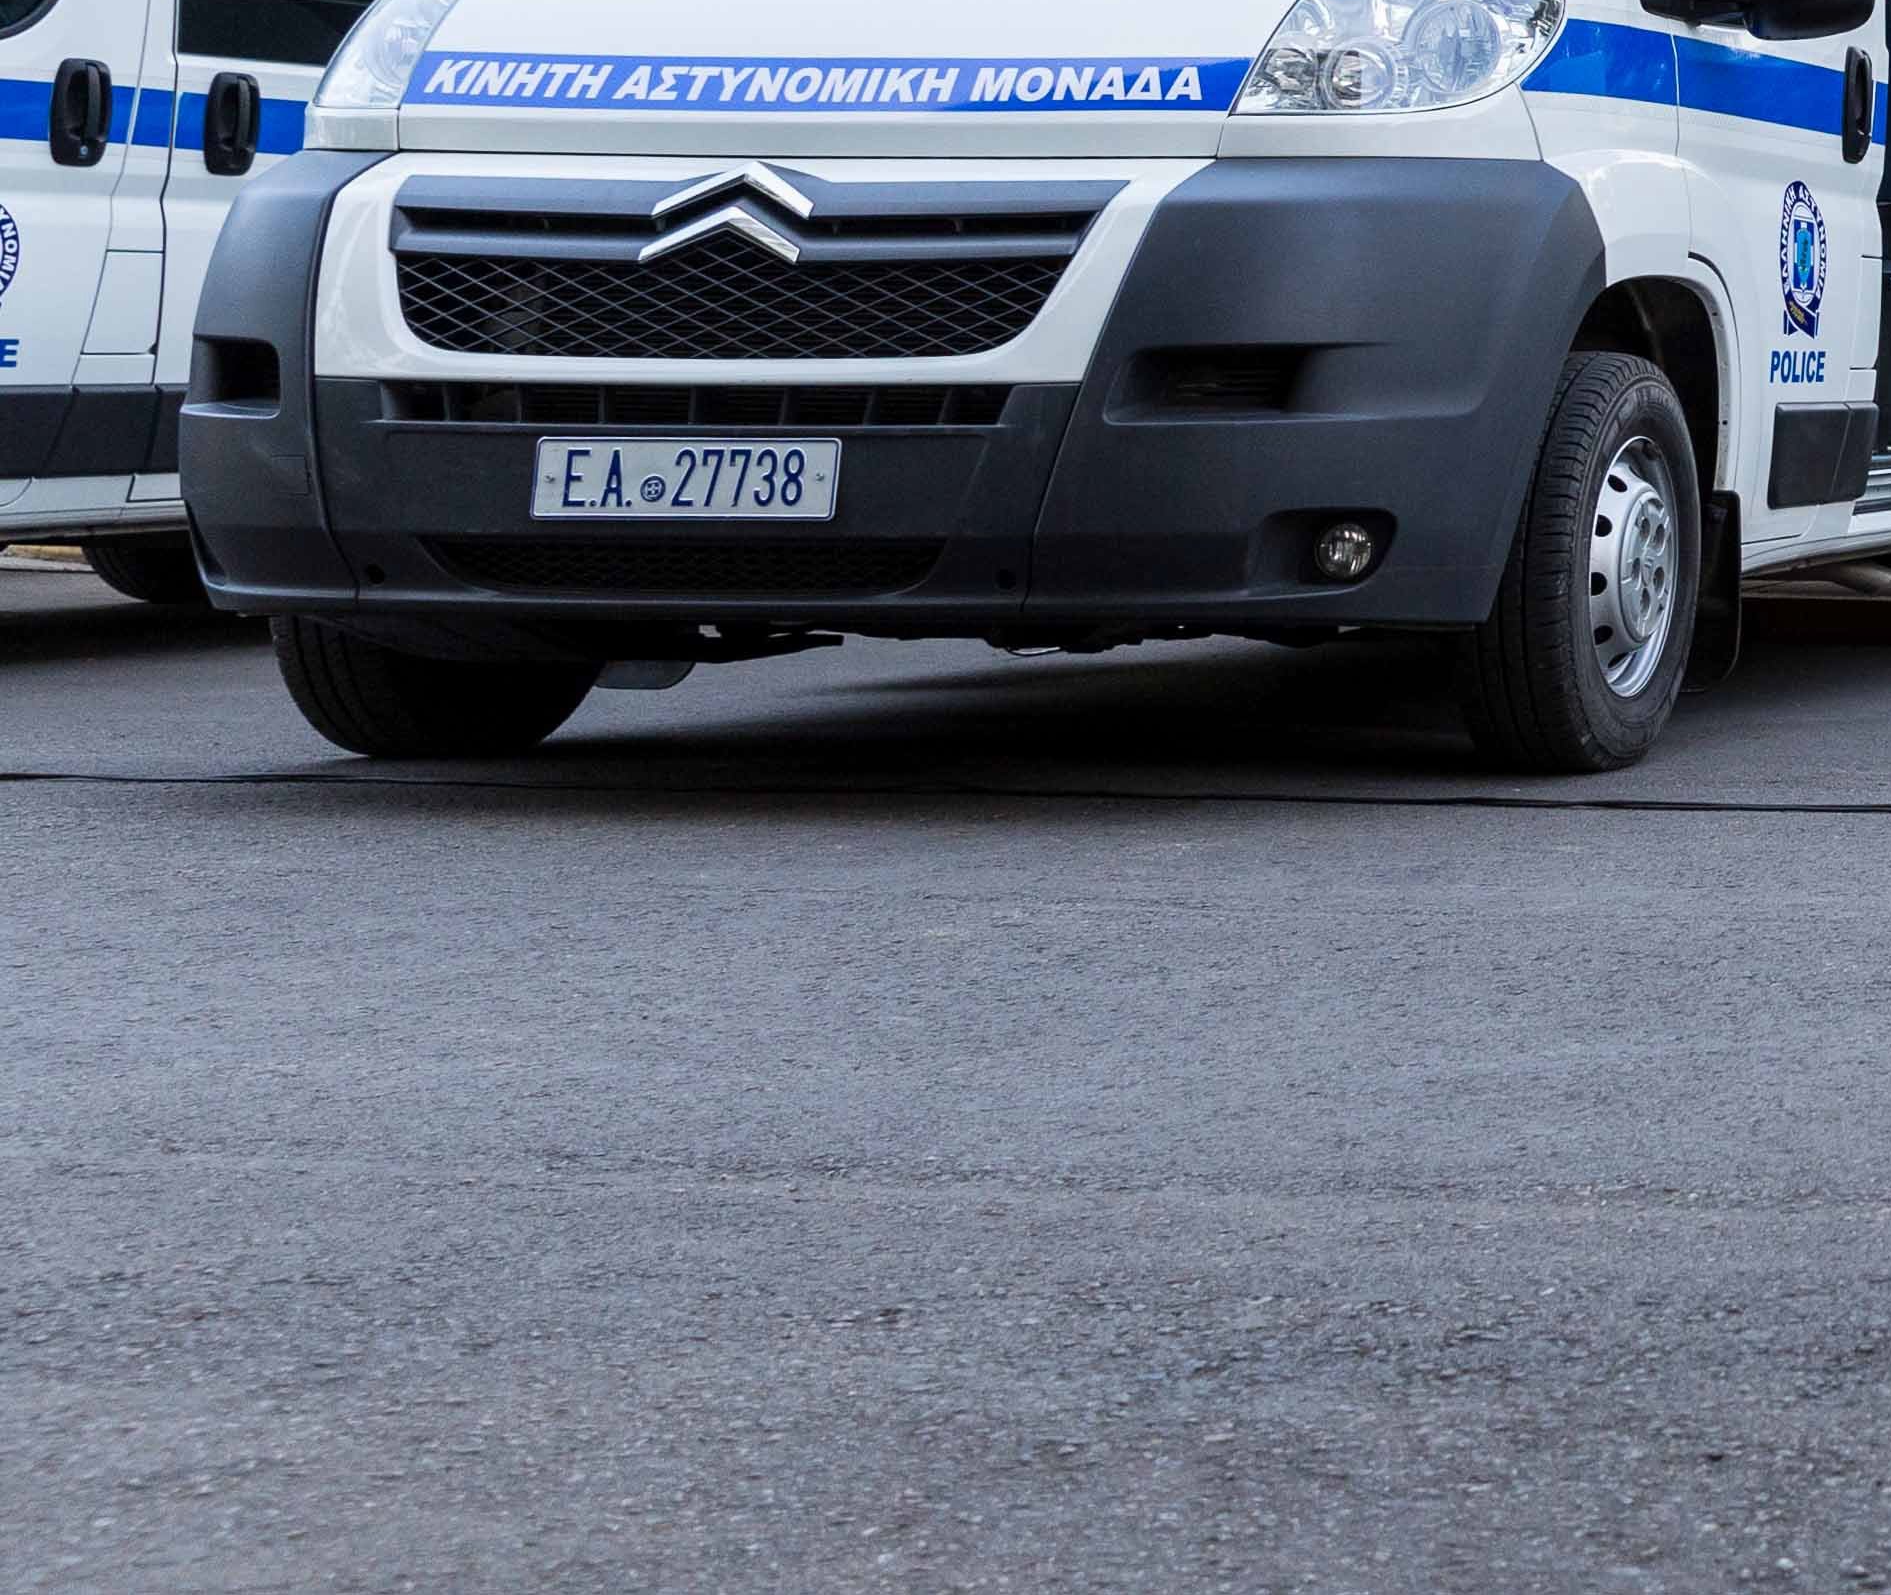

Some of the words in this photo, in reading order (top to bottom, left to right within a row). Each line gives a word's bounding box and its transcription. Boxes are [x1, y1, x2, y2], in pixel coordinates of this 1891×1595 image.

[424, 60, 614, 101] ΚΙΝΗΤΗ
[613, 66, 960, 103] ΑΣΤΥΝΟΜΙΚΗ
[969, 65, 1204, 102] ΜΟΝΑΔΑ
[1769, 350, 1826, 384] POLICE
[670, 448, 807, 508] 27738
